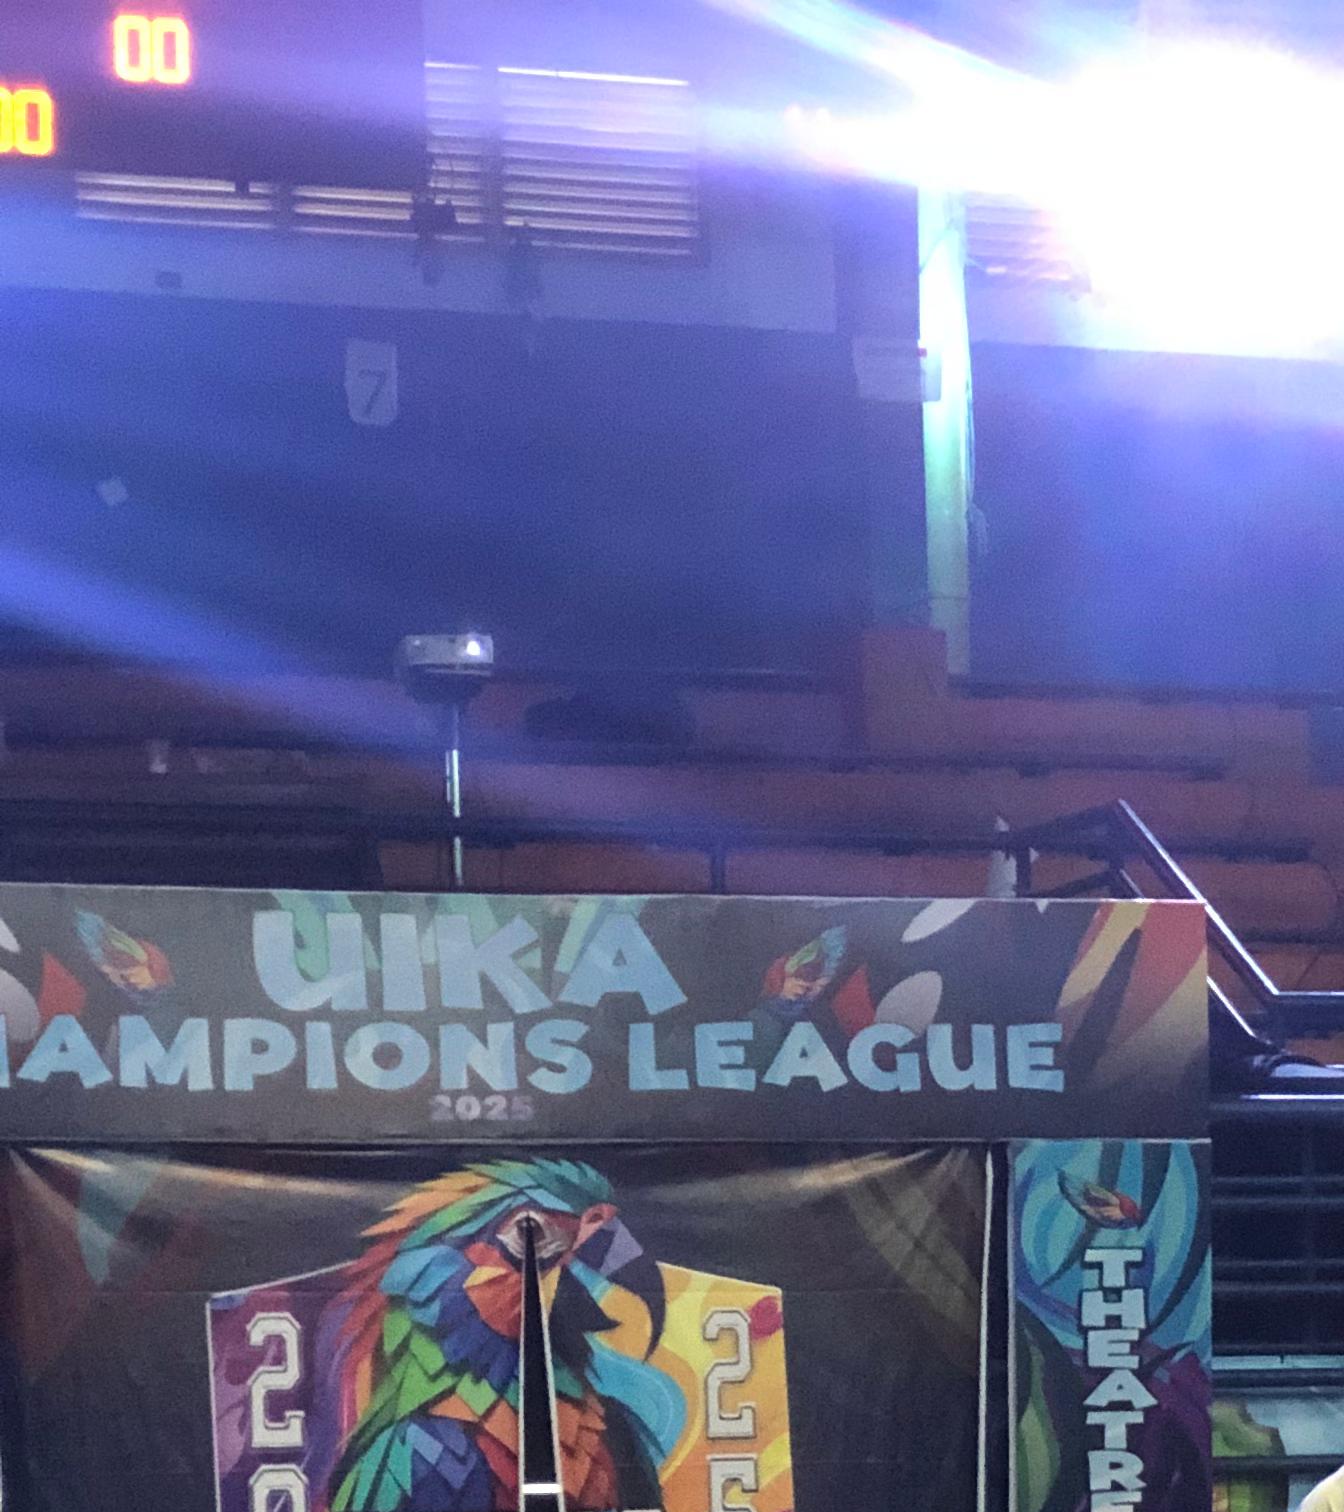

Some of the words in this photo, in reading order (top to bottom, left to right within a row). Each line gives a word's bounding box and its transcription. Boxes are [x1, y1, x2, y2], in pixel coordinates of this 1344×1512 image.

[112, 14, 191, 85] 00
[358, 368, 386, 417] 7
[252, 911, 688, 1015] UIKA
[0, 1014, 593, 1095] AMPIONS
[629, 1020, 1065, 1093] LEAGUE
[430, 1094, 536, 1122] 2025
